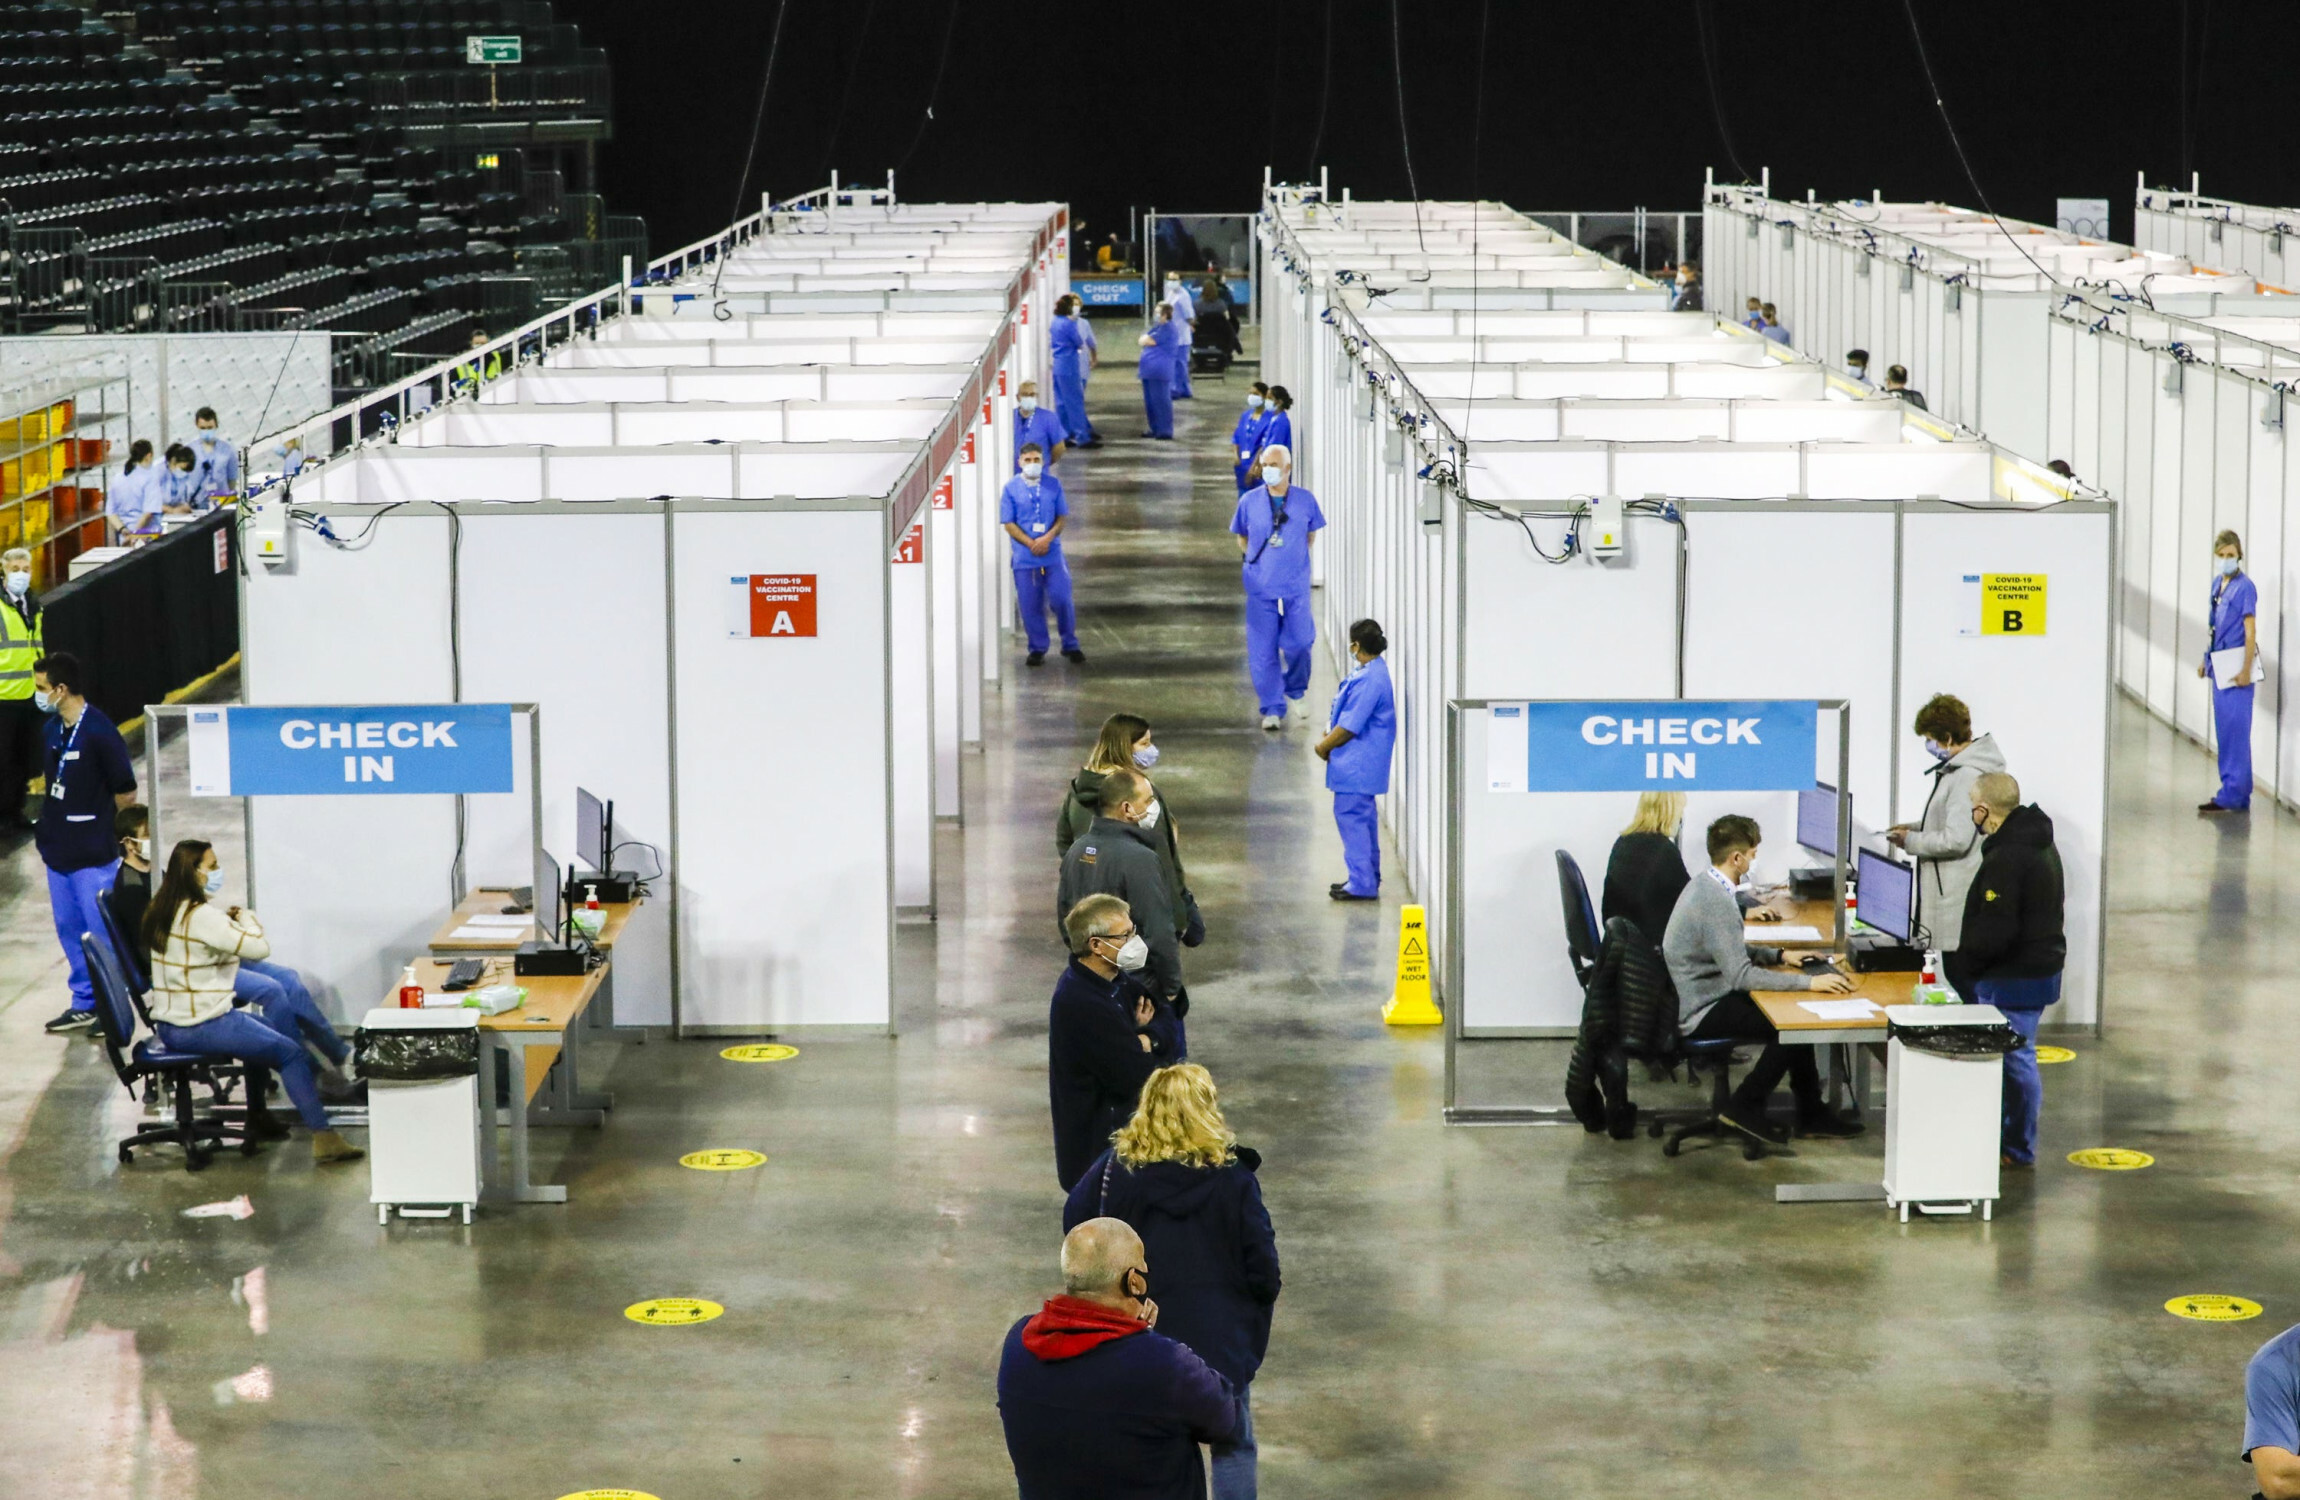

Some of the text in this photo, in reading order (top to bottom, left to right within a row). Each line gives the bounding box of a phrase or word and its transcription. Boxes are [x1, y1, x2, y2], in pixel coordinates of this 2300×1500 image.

[1083, 284, 1129, 294] CHECK
[1092, 294, 1120, 303] OUT
[763, 577, 801, 585] COVID-19
[770, 610, 795, 634] A
[2003, 610, 2023, 632] B
[280, 719, 458, 750] CHECK
[1581, 715, 1763, 746] CHECK
[344, 755, 394, 782] IN
[1645, 752, 1696, 779] IN
